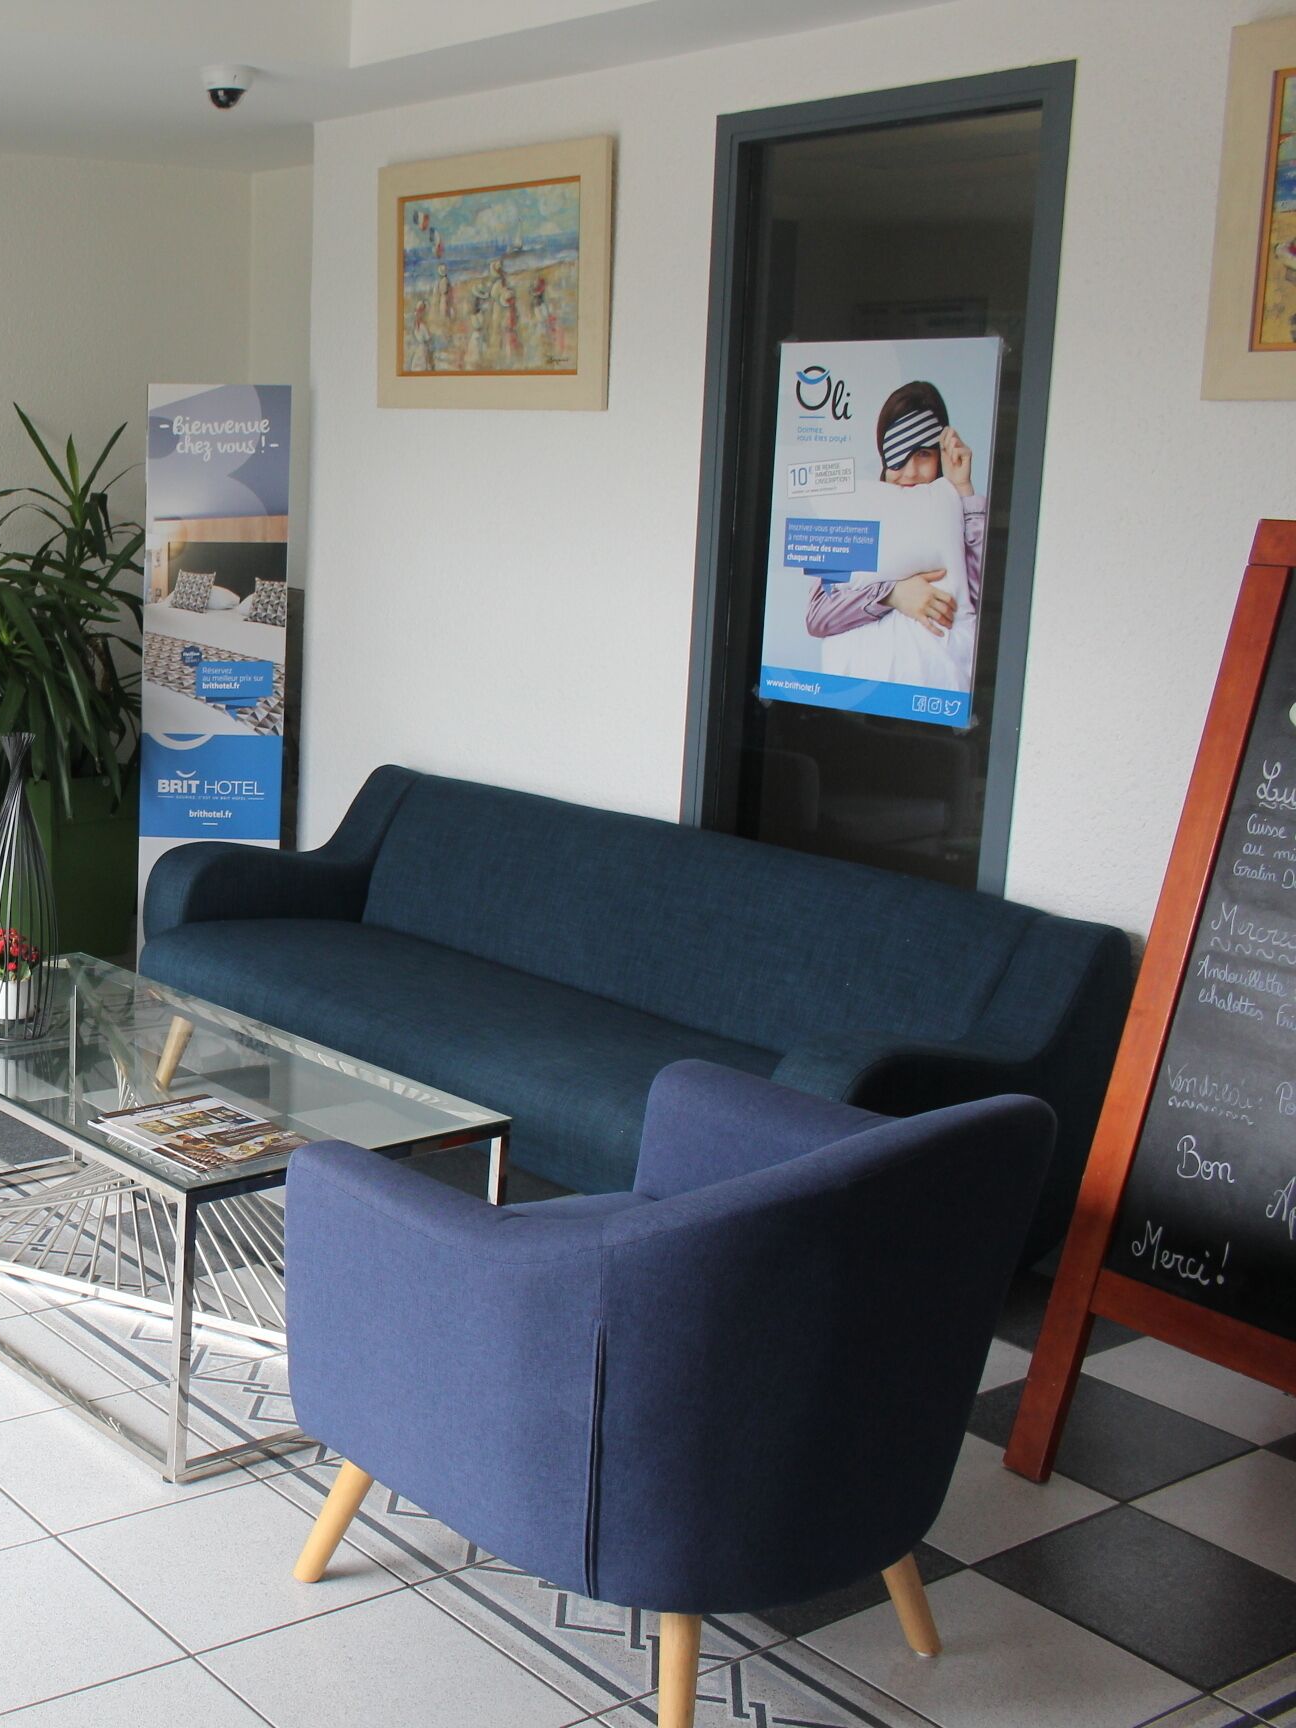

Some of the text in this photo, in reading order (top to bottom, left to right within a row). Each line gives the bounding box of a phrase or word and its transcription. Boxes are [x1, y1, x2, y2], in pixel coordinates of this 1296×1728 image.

[176, 435, 211, 462] chez
[216, 439, 256, 454] vous
[157, 779, 265, 796] BRIT HOTEL
[189, 809, 233, 819] brithotel.fr
[1247, 813, 1287, 839] Cuisse
[1233, 859, 1277, 882] Gratin
[1177, 1134, 1235, 1184] Bon
